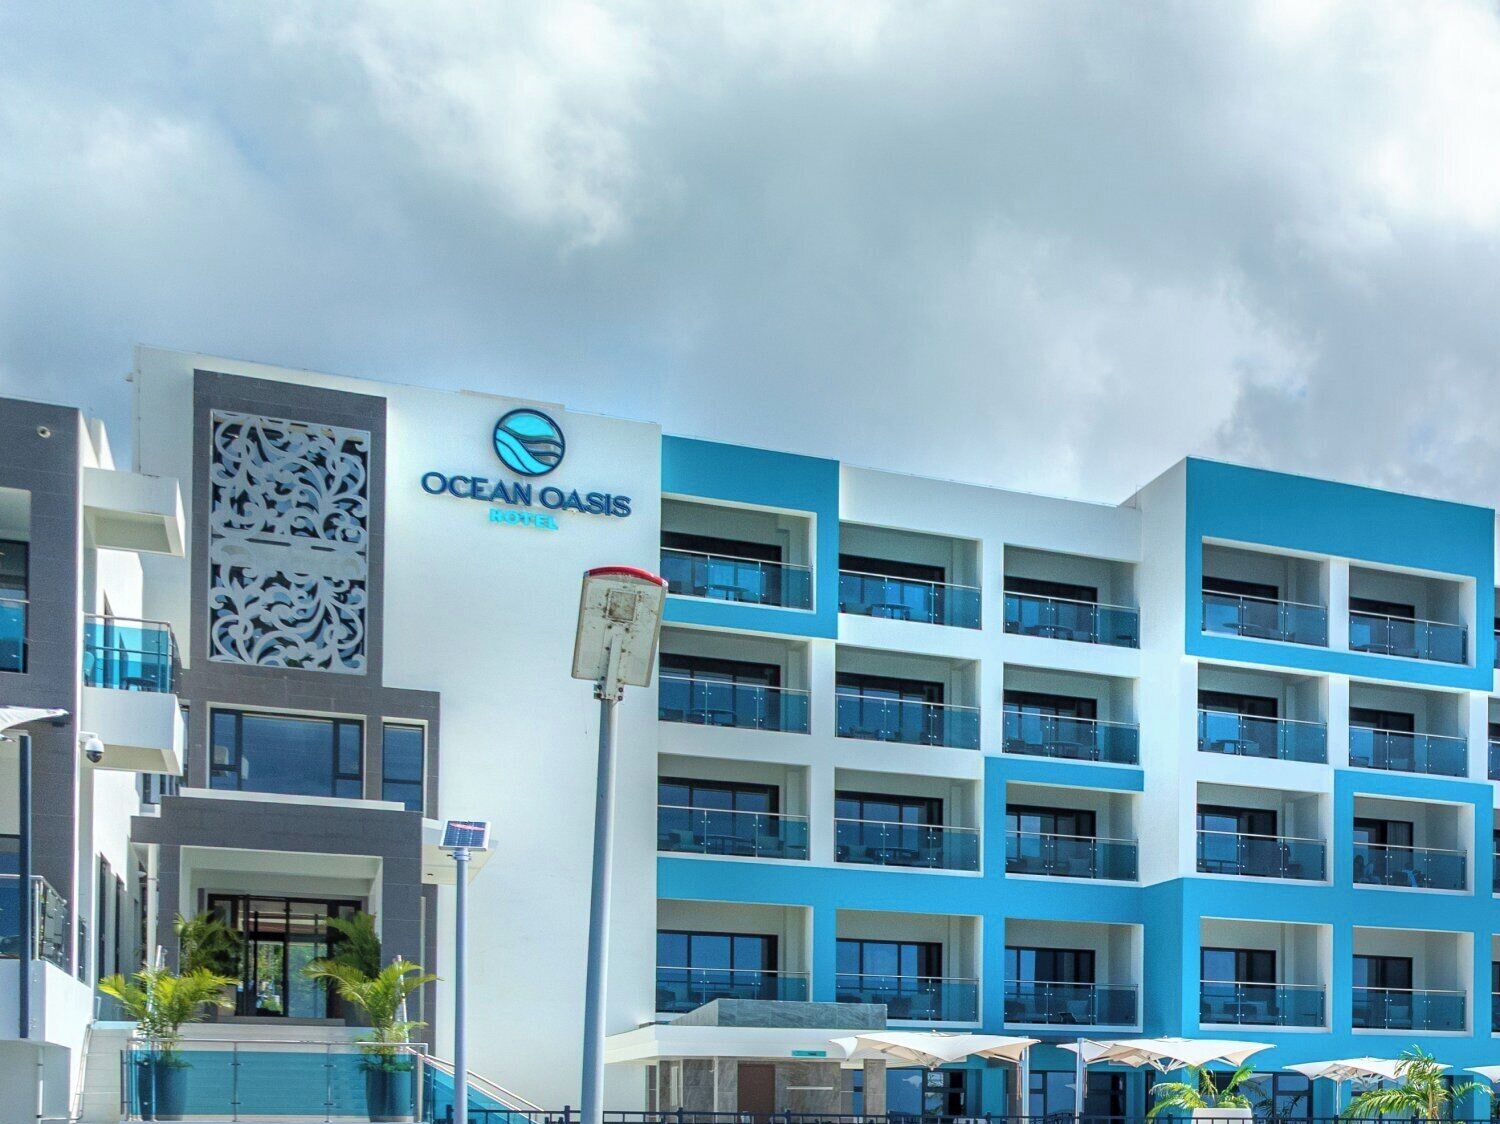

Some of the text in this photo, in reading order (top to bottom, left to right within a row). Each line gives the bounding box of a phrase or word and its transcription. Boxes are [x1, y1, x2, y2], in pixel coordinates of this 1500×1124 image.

[421, 472, 632, 518] OCEAN OASIS
[489, 508, 559, 531] HOTEL
